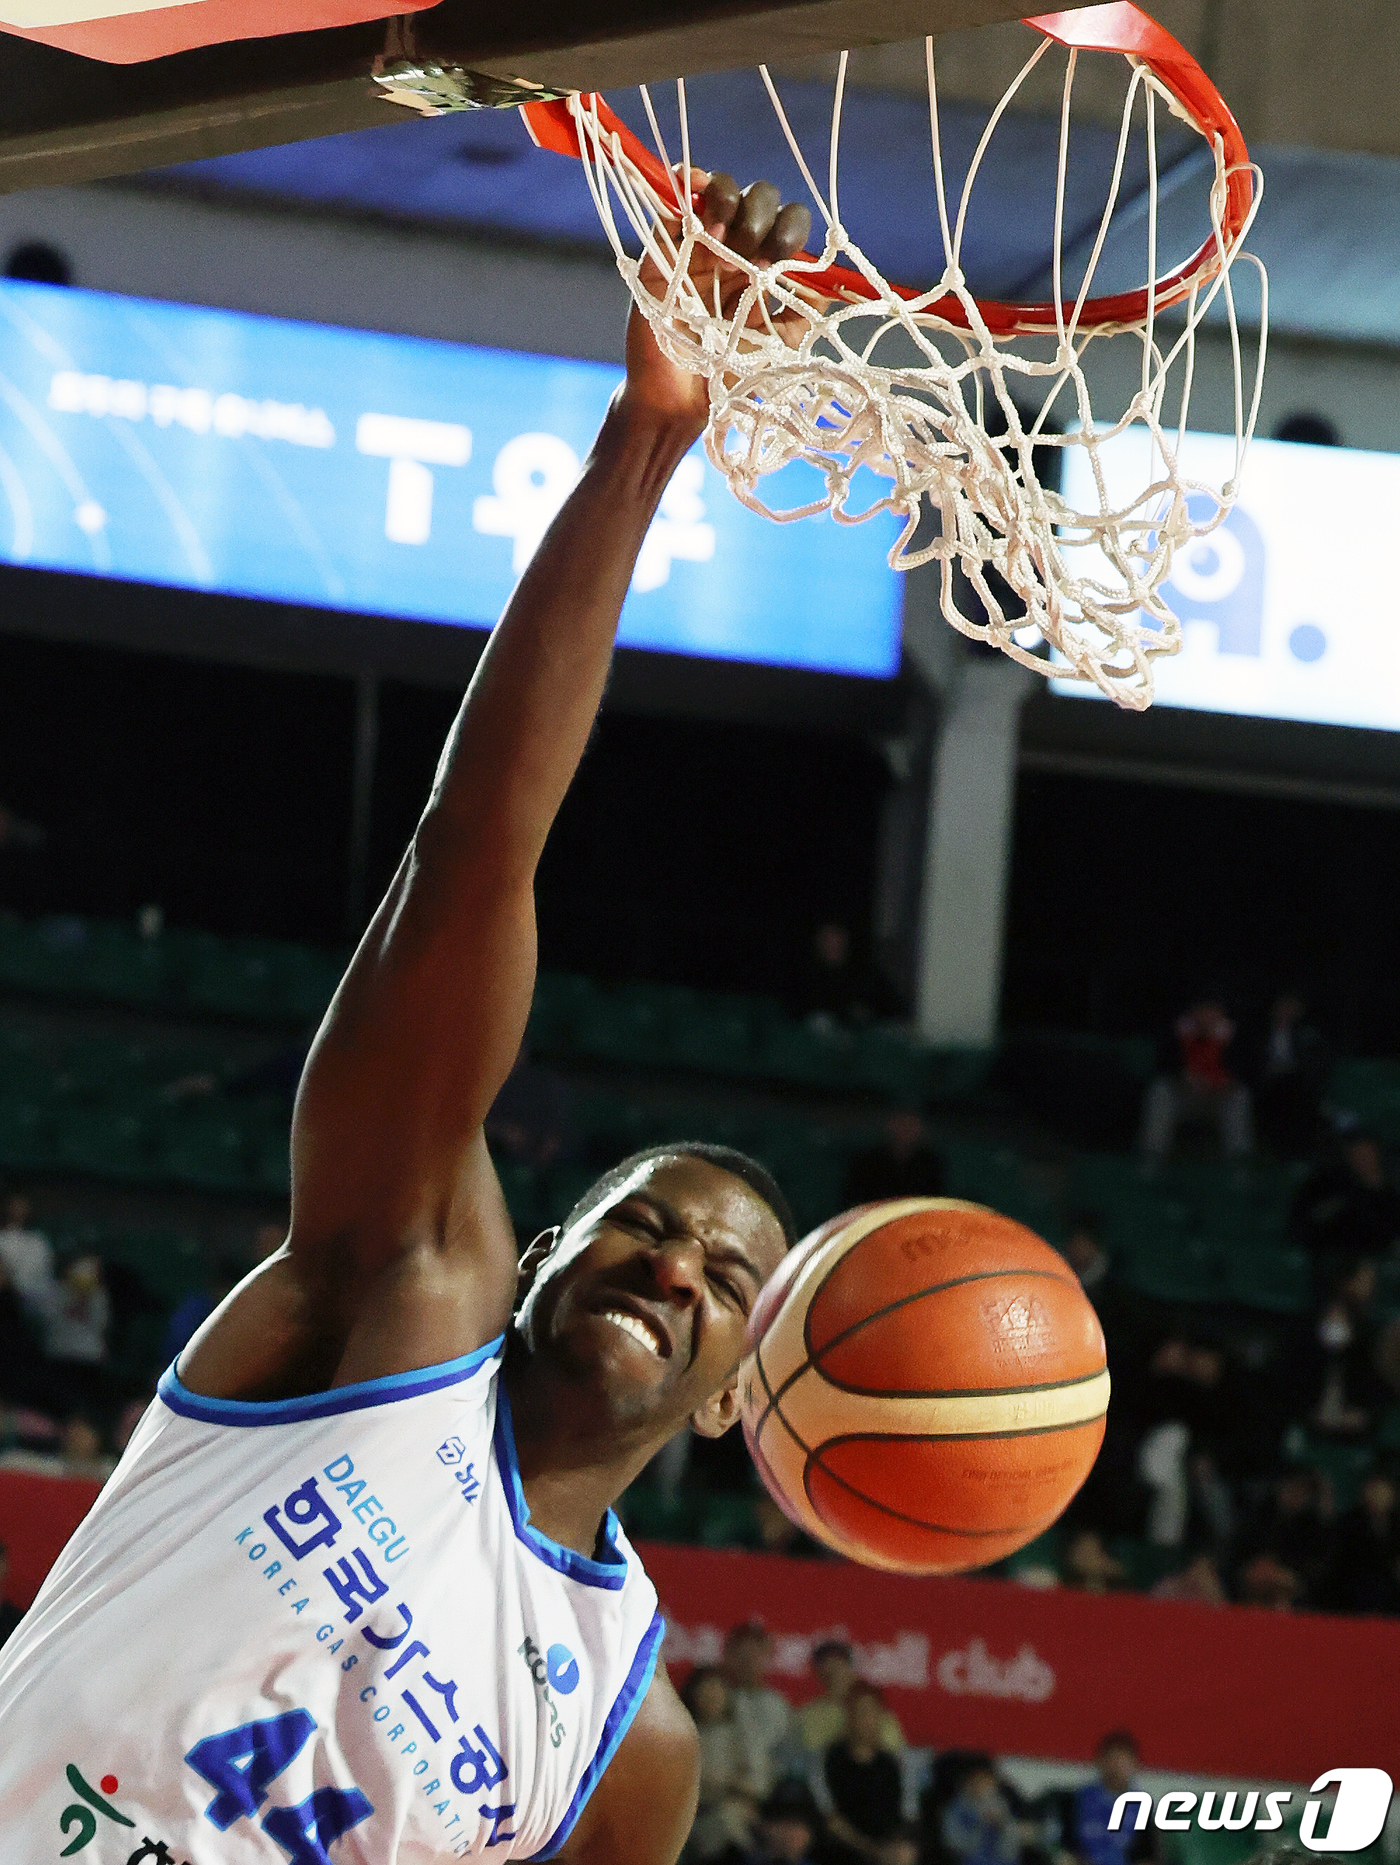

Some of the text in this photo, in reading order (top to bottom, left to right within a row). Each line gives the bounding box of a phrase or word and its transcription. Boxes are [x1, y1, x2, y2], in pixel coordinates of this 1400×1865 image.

[323, 1453, 410, 1563] DAEGU
[234, 1526, 310, 1616] KOREA
[316, 1624, 359, 1672] GAS
[263, 1476, 517, 1848] 한국가스공사
[936, 1636, 1057, 1702] club
